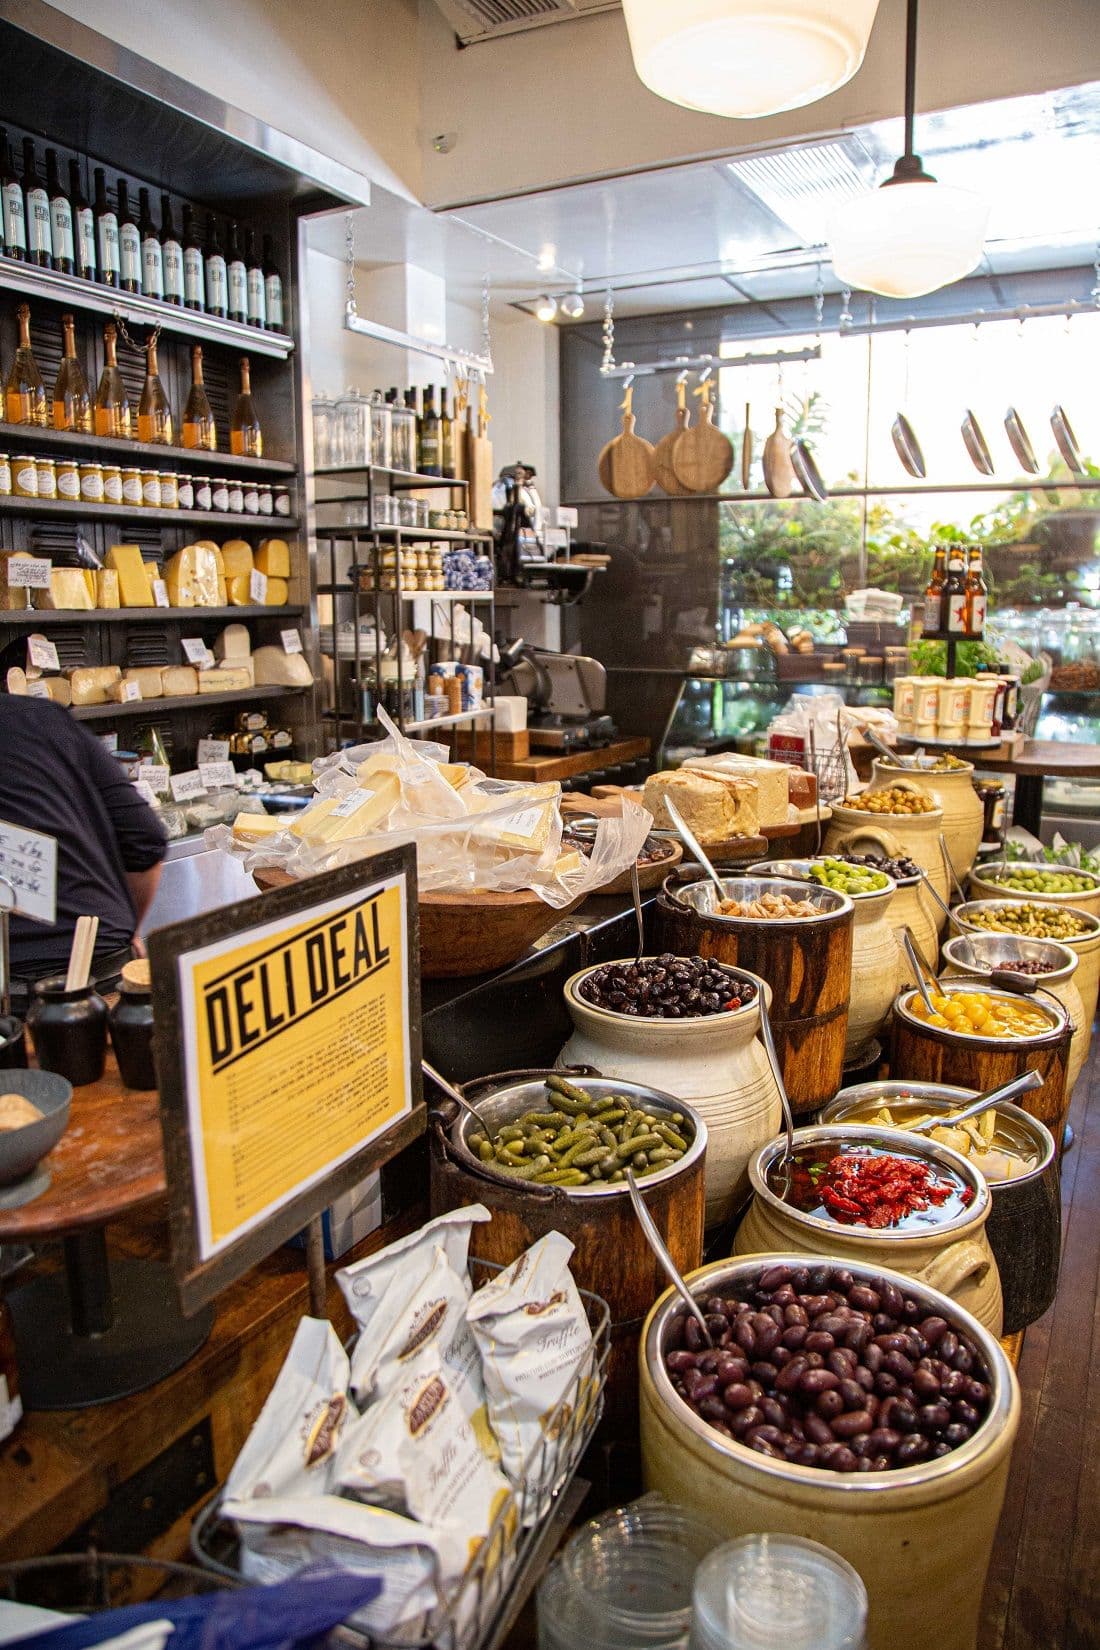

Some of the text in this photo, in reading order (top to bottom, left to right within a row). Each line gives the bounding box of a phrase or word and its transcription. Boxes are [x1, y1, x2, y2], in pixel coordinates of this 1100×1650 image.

[205, 902, 390, 1063] DELI DEAL
[536, 1325, 580, 1352] Truffle
